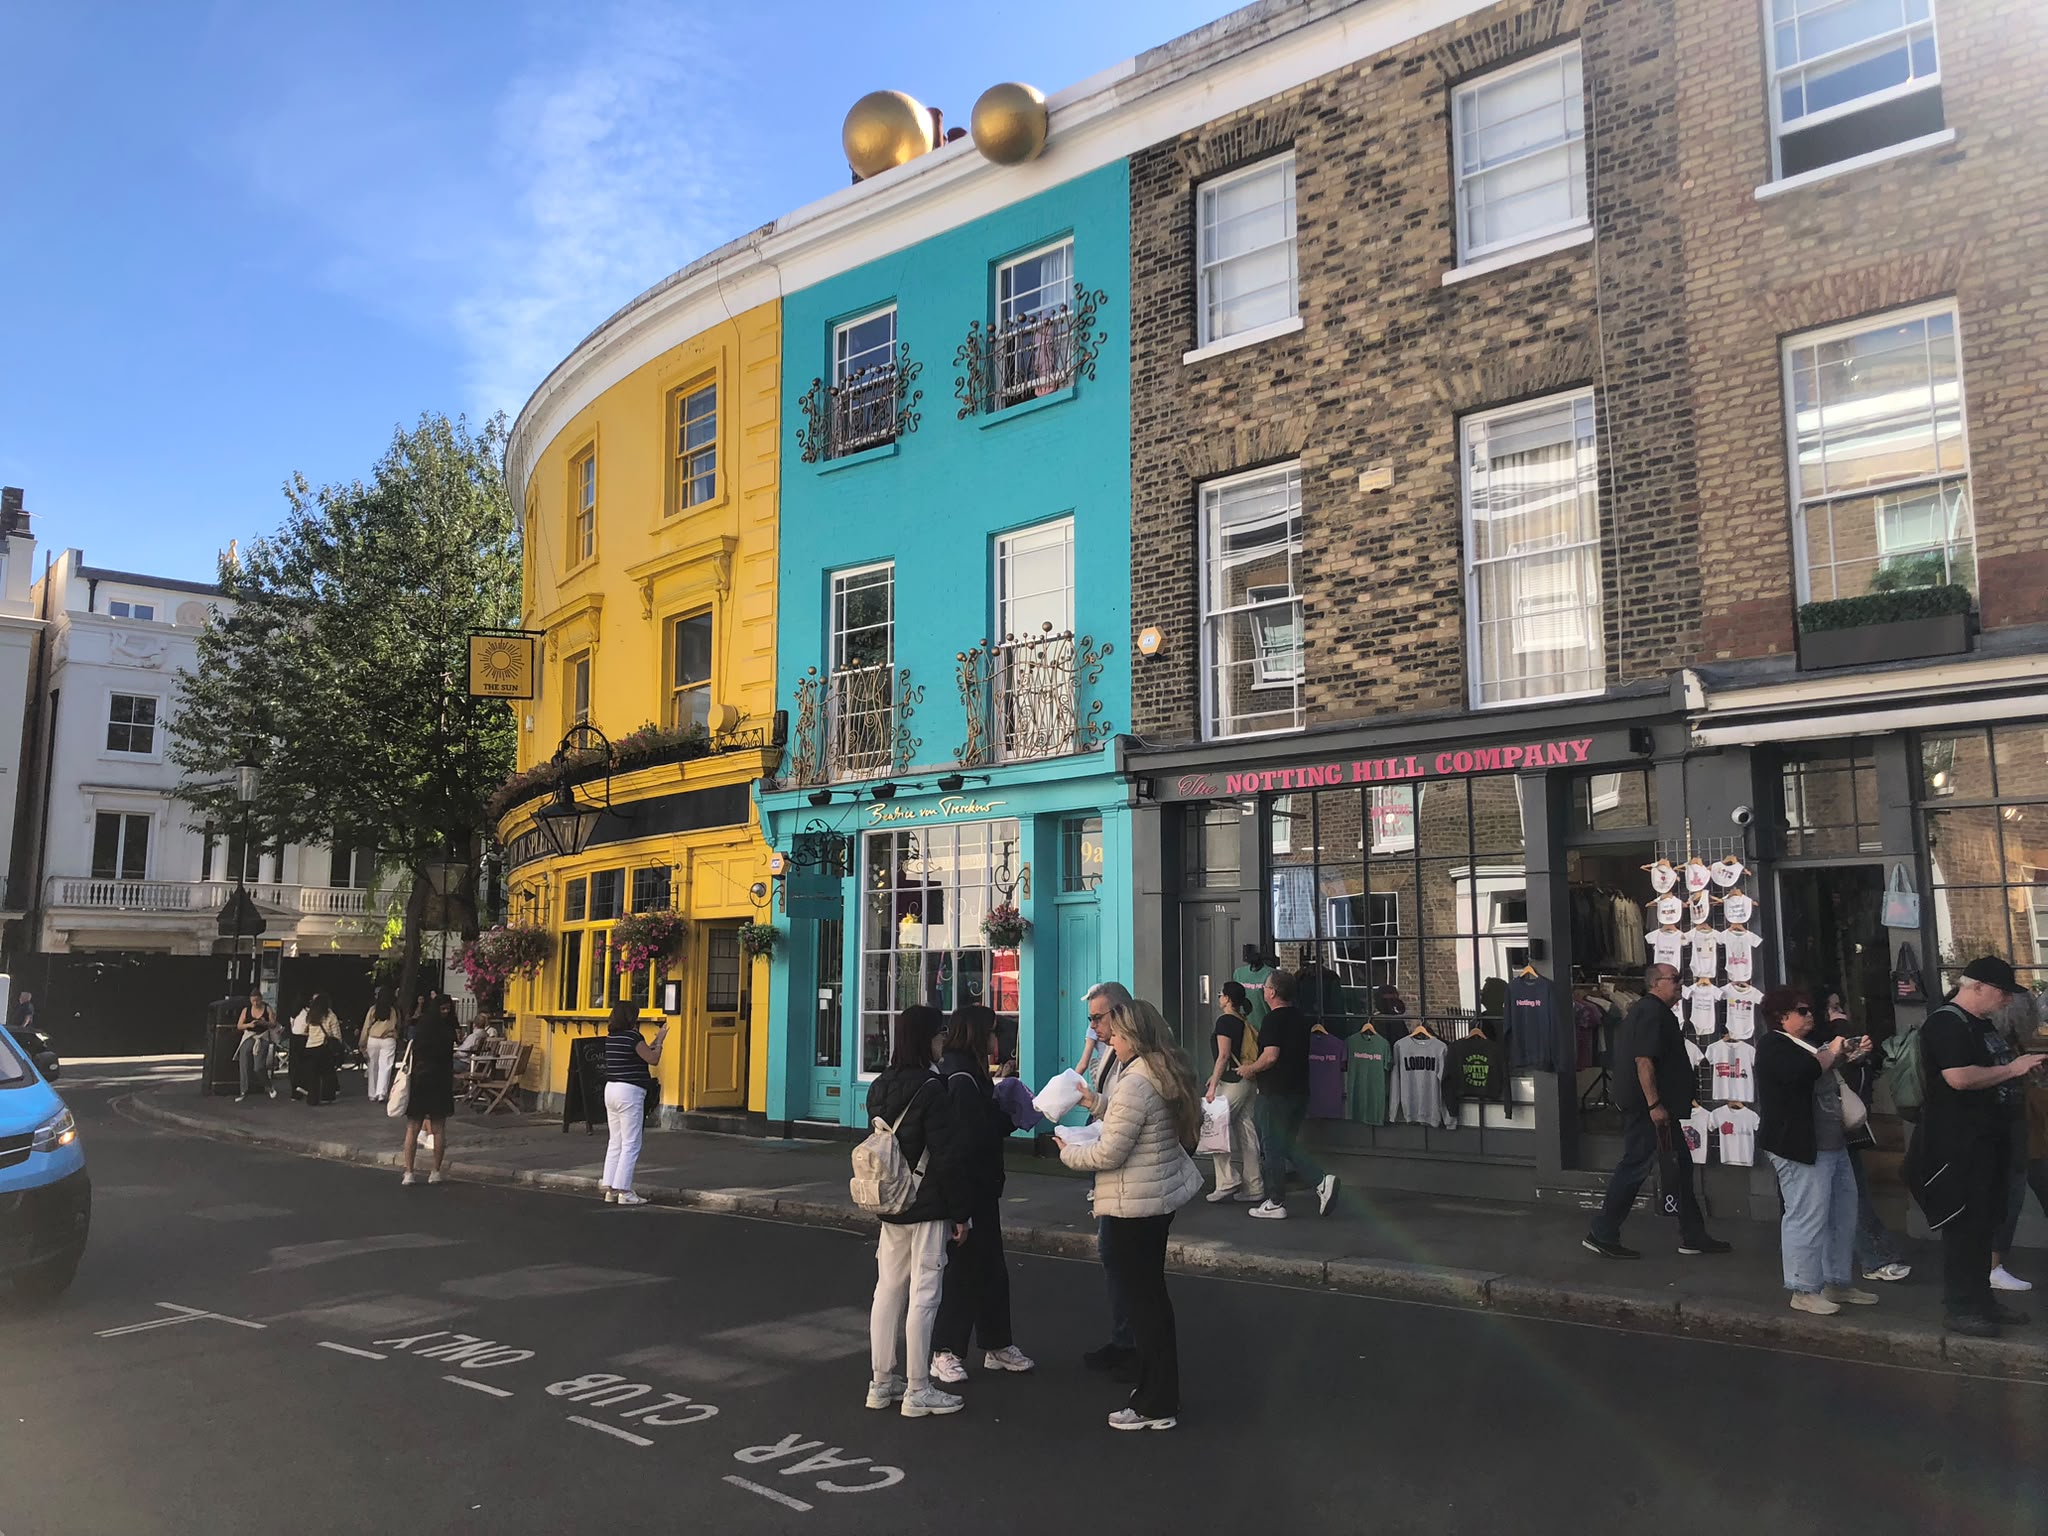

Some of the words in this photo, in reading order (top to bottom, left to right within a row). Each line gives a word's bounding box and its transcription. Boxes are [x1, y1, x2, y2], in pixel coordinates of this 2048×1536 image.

[1178, 773, 1218, 797] The
[1225, 764, 1343, 794] NOTTING
[1351, 756, 1425, 783] HILL
[1435, 738, 1593, 774] COMPANY
[865, 803, 917, 825] Beatrice
[920, 808, 938, 817] von
[1081, 841, 1103, 863] 9a
[1215, 904, 1226, 913] 11A
[1516, 999, 1535, 1007] Notting
[1354, 1052, 1373, 1061] Notting
[1404, 1056, 1436, 1071] LONDON
[1463, 1065, 1489, 1074] NOTTIN
[372, 1331, 535, 1368] ONLY
[545, 1373, 719, 1425] CLUB
[733, 1433, 905, 1493] CAR
